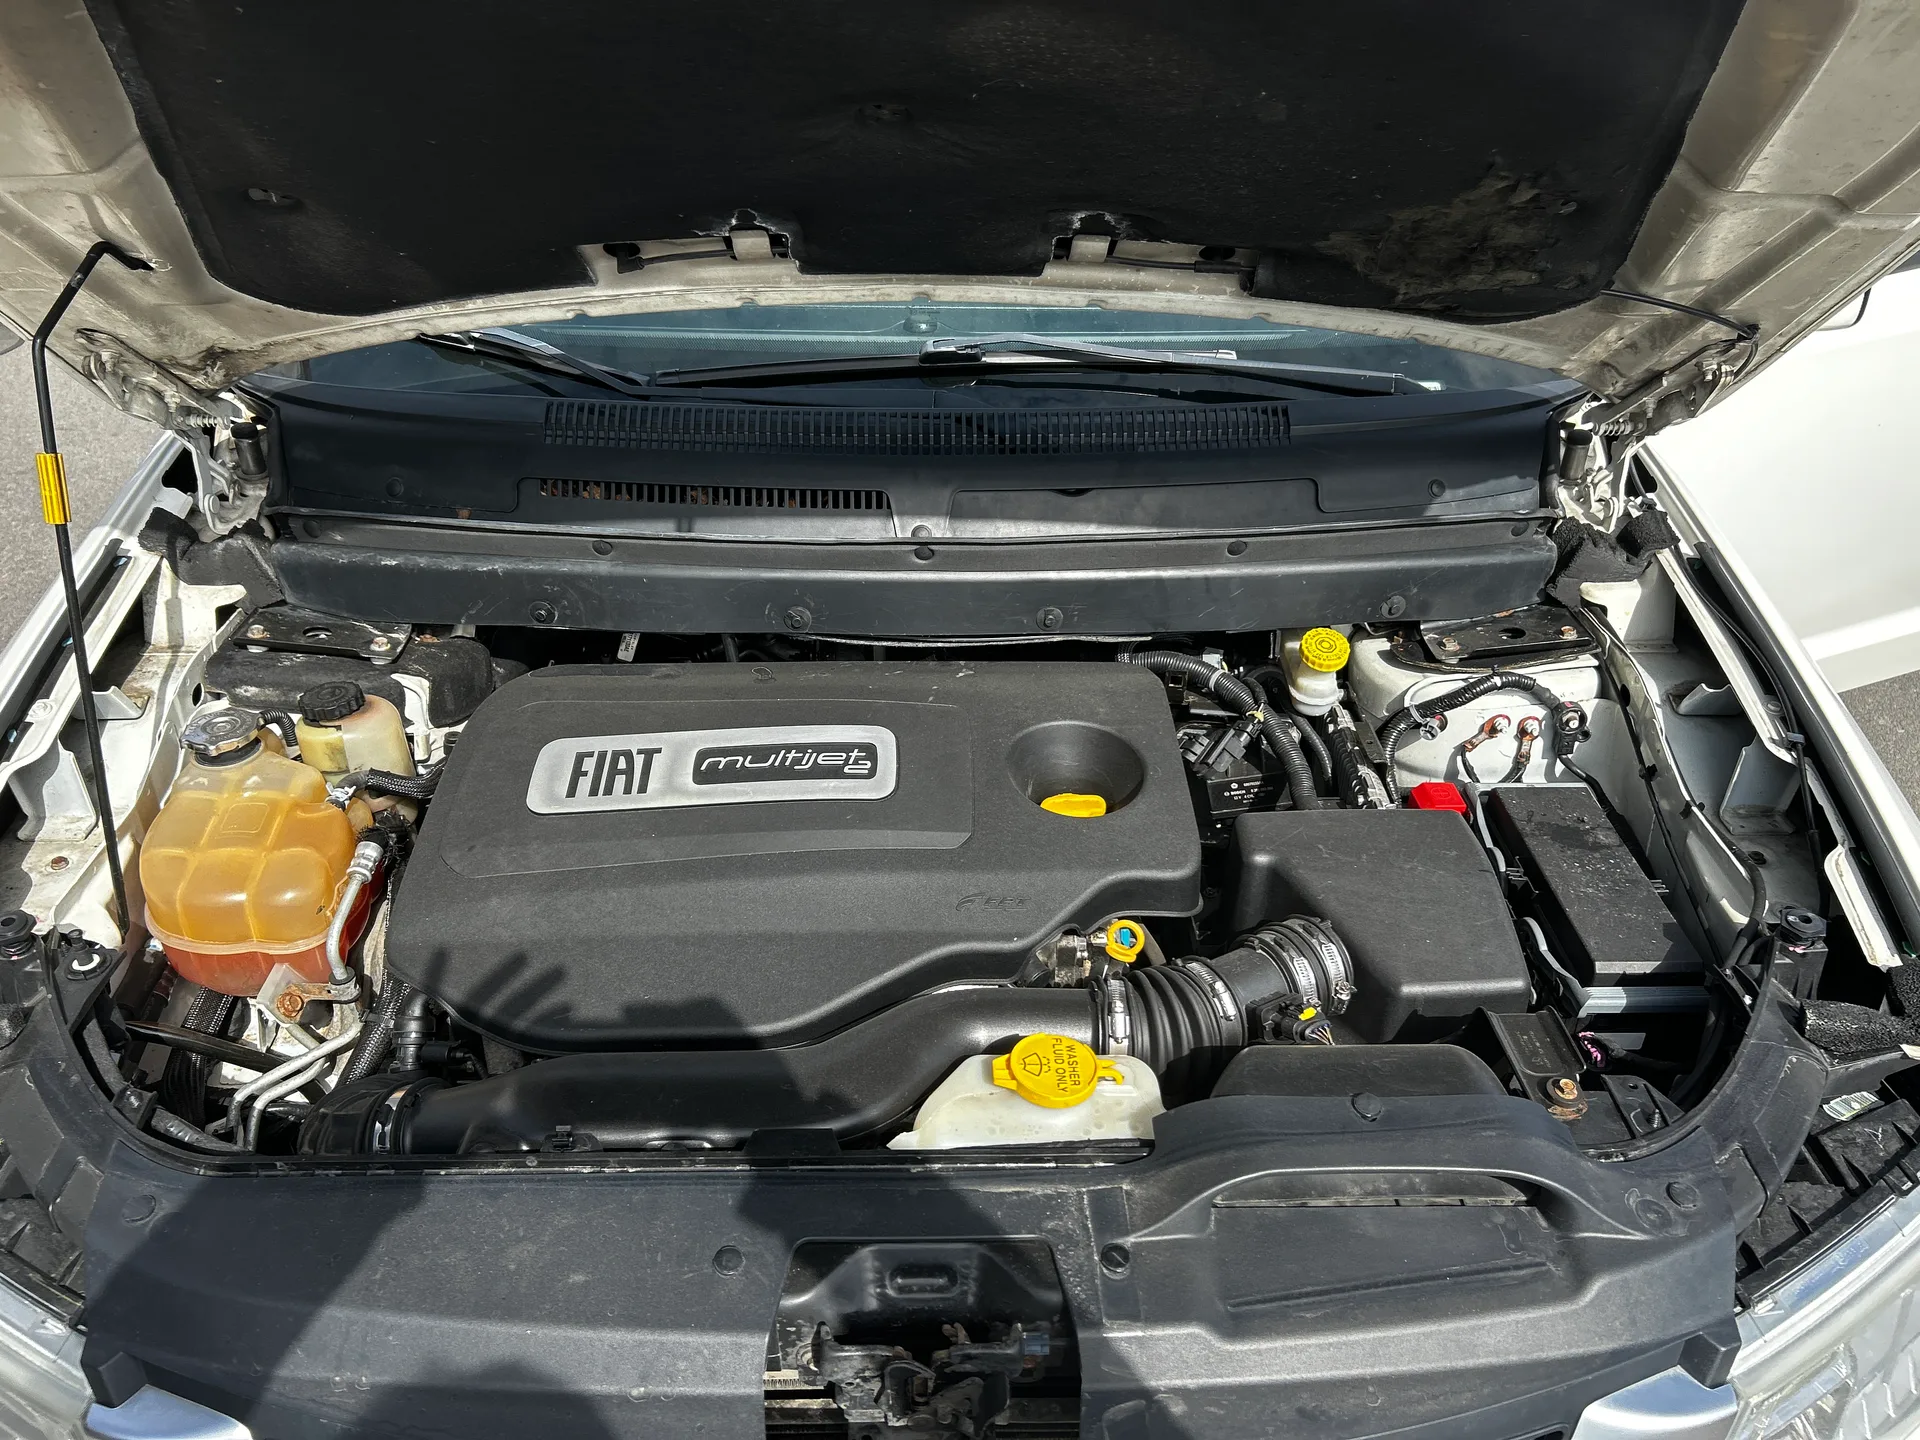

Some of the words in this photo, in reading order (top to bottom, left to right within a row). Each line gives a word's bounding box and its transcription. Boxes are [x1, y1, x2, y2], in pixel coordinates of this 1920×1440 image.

[564, 747, 662, 799] FIAT
[1052, 1038, 1064, 1065] FLUID
[1066, 1044, 1081, 1087] WASHER
[1056, 1067, 1069, 1093] ONLY
